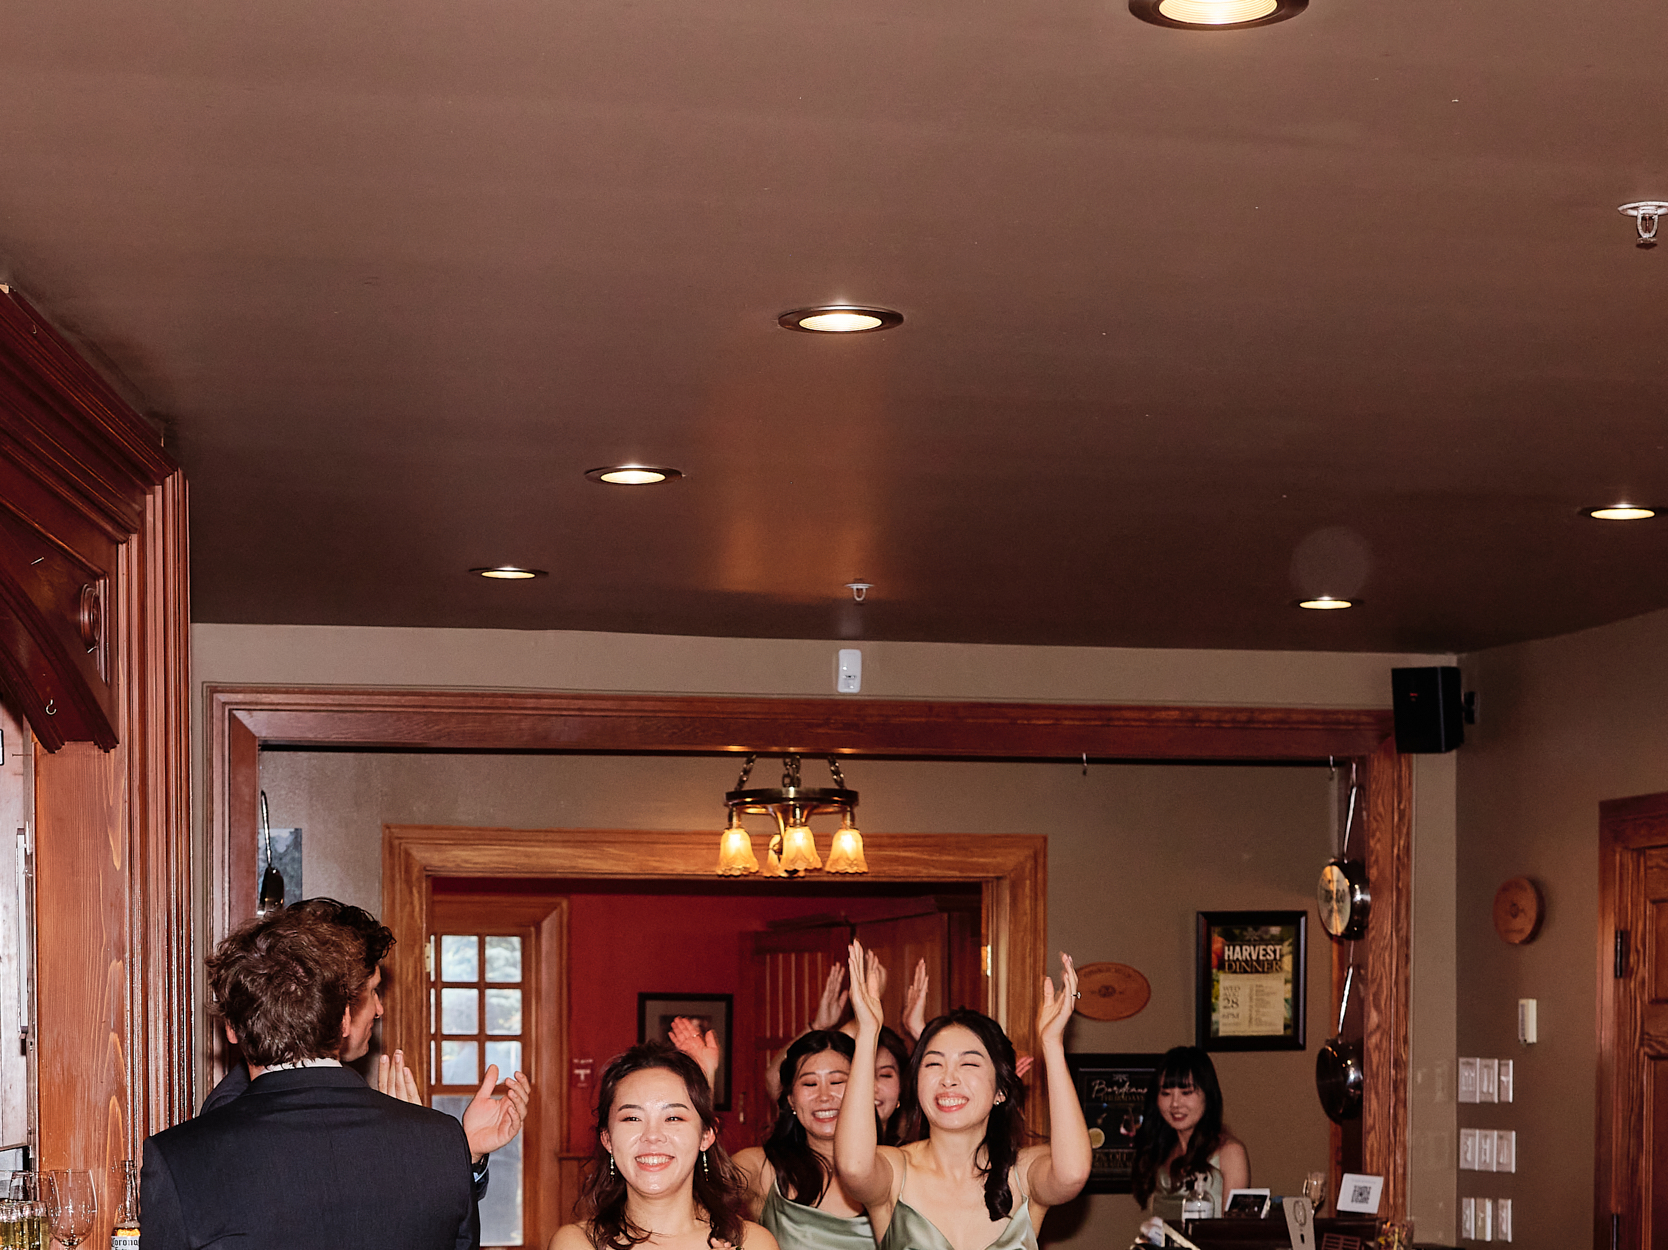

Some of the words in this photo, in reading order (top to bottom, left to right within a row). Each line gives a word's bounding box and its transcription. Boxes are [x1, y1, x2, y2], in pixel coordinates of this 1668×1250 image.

[1224, 945, 1282, 960] HARVEST
[1225, 961, 1281, 973] DINNER
[1222, 997, 1239, 1009] 28
[112, 1238, 138, 1247] Corona
